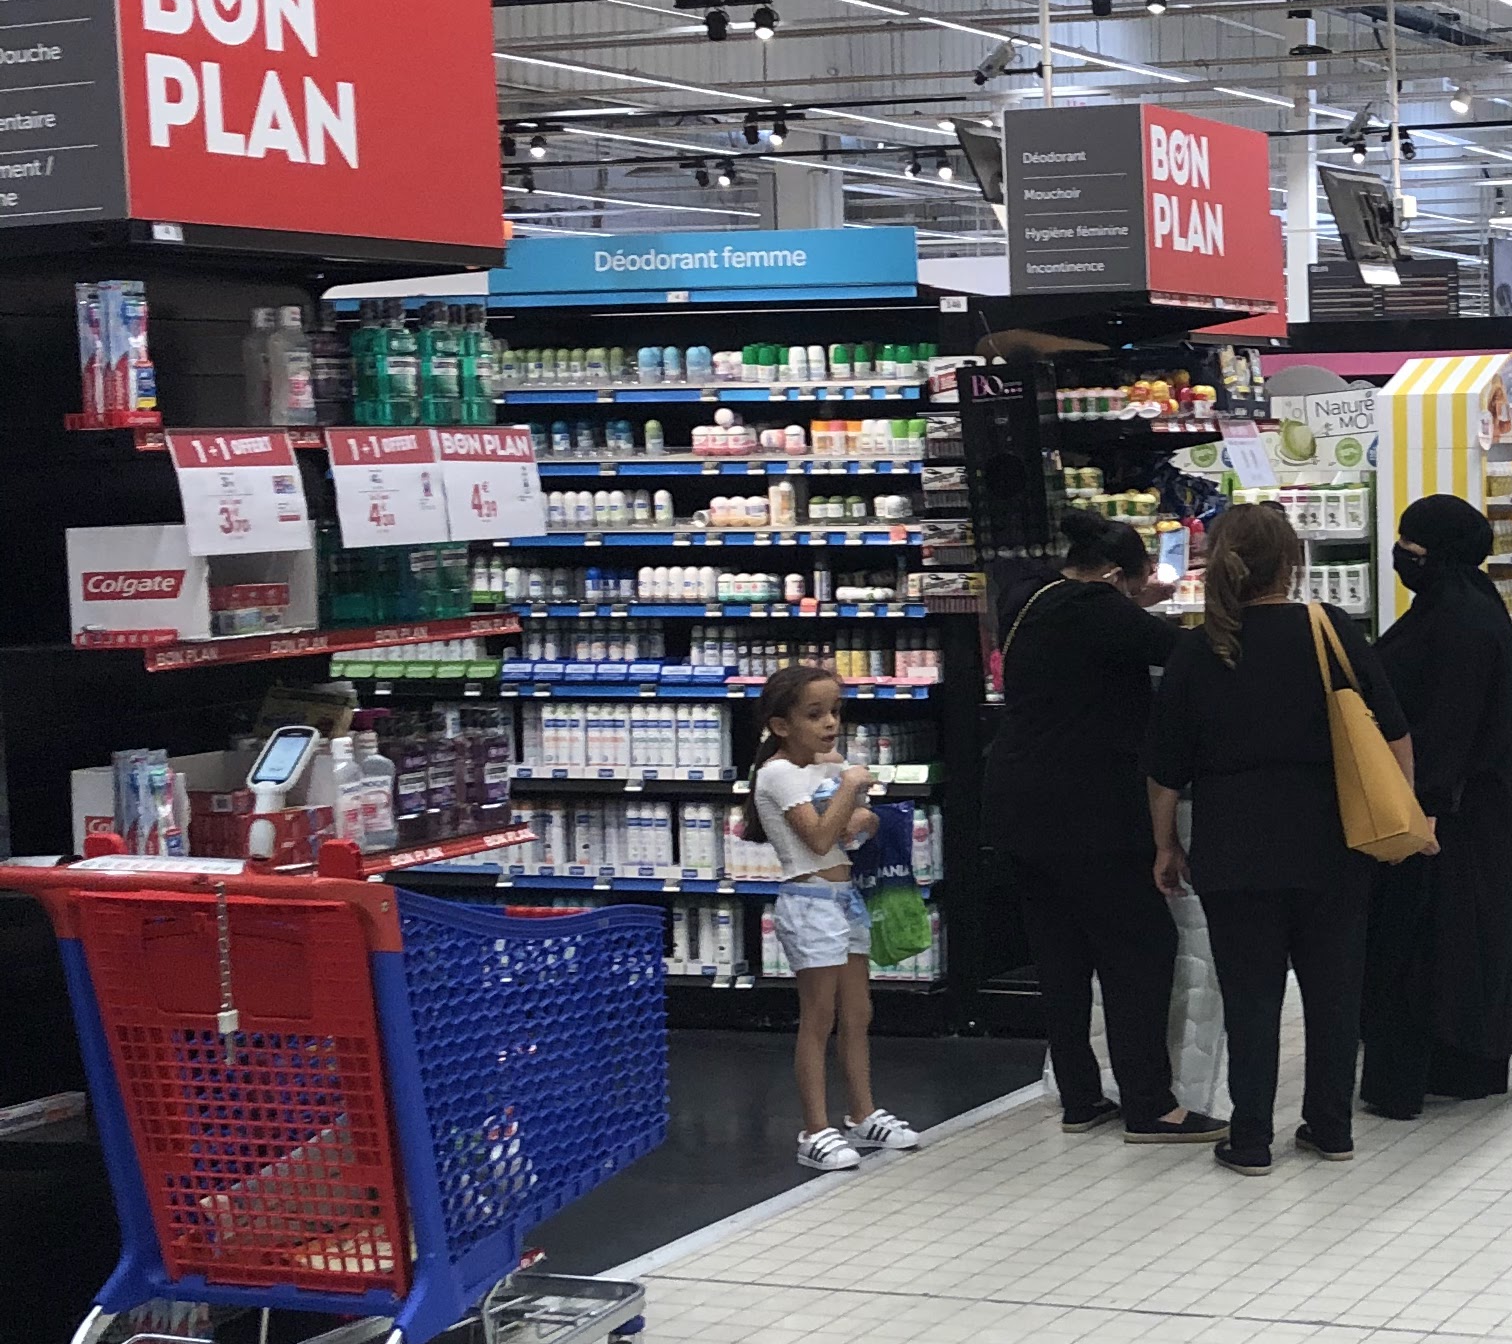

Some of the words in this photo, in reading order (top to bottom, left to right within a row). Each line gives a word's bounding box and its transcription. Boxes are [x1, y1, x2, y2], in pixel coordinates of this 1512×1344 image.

[145, 53, 358, 169] PLAN
[1022, 151, 1087, 164] Déodorant
[1150, 123, 1211, 190] BON
[1023, 187, 1081, 200] Mouchoir
[1024, 226, 1075, 242] Hygiène
[1076, 225, 1129, 237] féminine
[1152, 192, 1225, 257] PLAN
[594, 249, 718, 272] Déodorant
[722, 246, 807, 268] femme
[1026, 261, 1106, 273] Incontinence
[440, 432, 484, 456] BON
[483, 434, 530, 457] PLAN
[86, 575, 176, 597] Colgate
